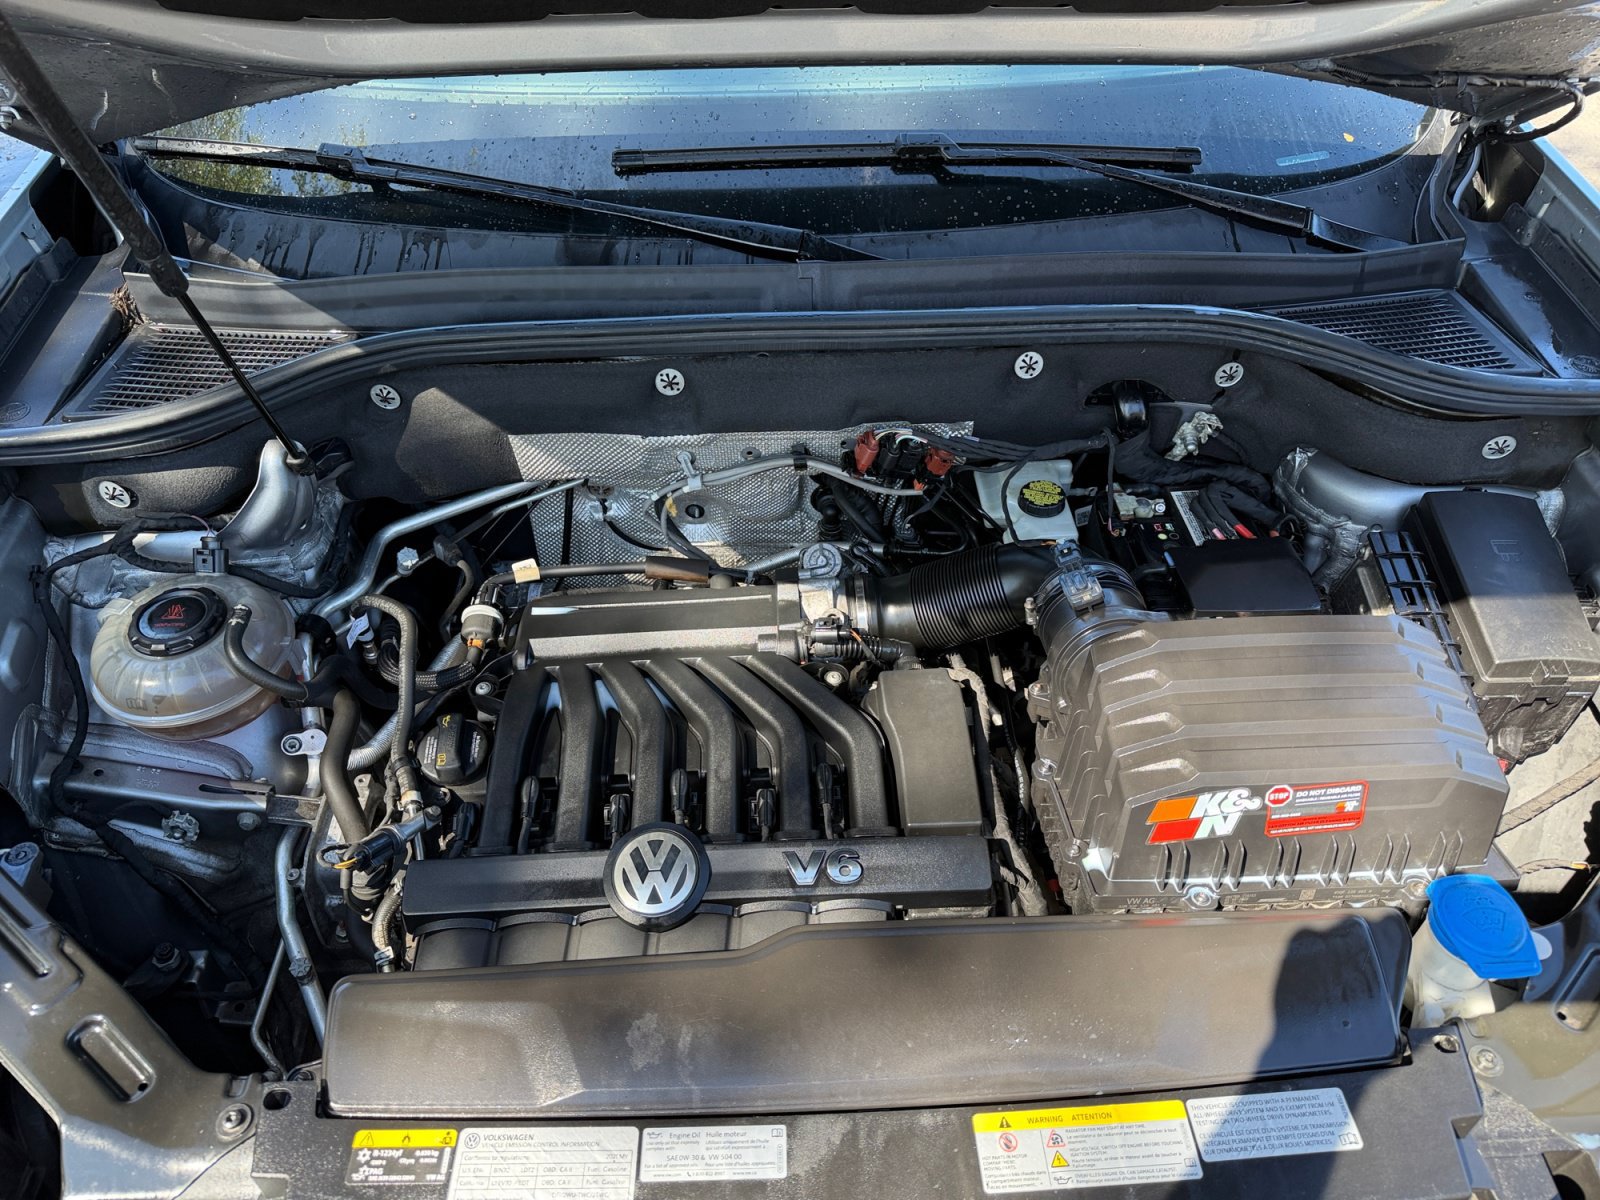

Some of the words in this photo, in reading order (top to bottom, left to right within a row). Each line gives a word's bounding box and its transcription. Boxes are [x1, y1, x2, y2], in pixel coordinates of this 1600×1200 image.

[1269, 792, 1289, 800] STOP
[1296, 790, 1308, 798] DO
[1327, 785, 1362, 794] DISCARD
[1189, 787, 1262, 839] K&N
[613, 829, 699, 917] VW
[782, 848, 865, 886] V6
[1126, 897, 1141, 905] VW
[1142, 897, 1156, 905] AG
[1027, 1115, 1063, 1124] WARNING
[1072, 1112, 1113, 1121] ATTENTION
[669, 1132, 690, 1140] Engine
[691, 1131, 701, 1139] Oil
